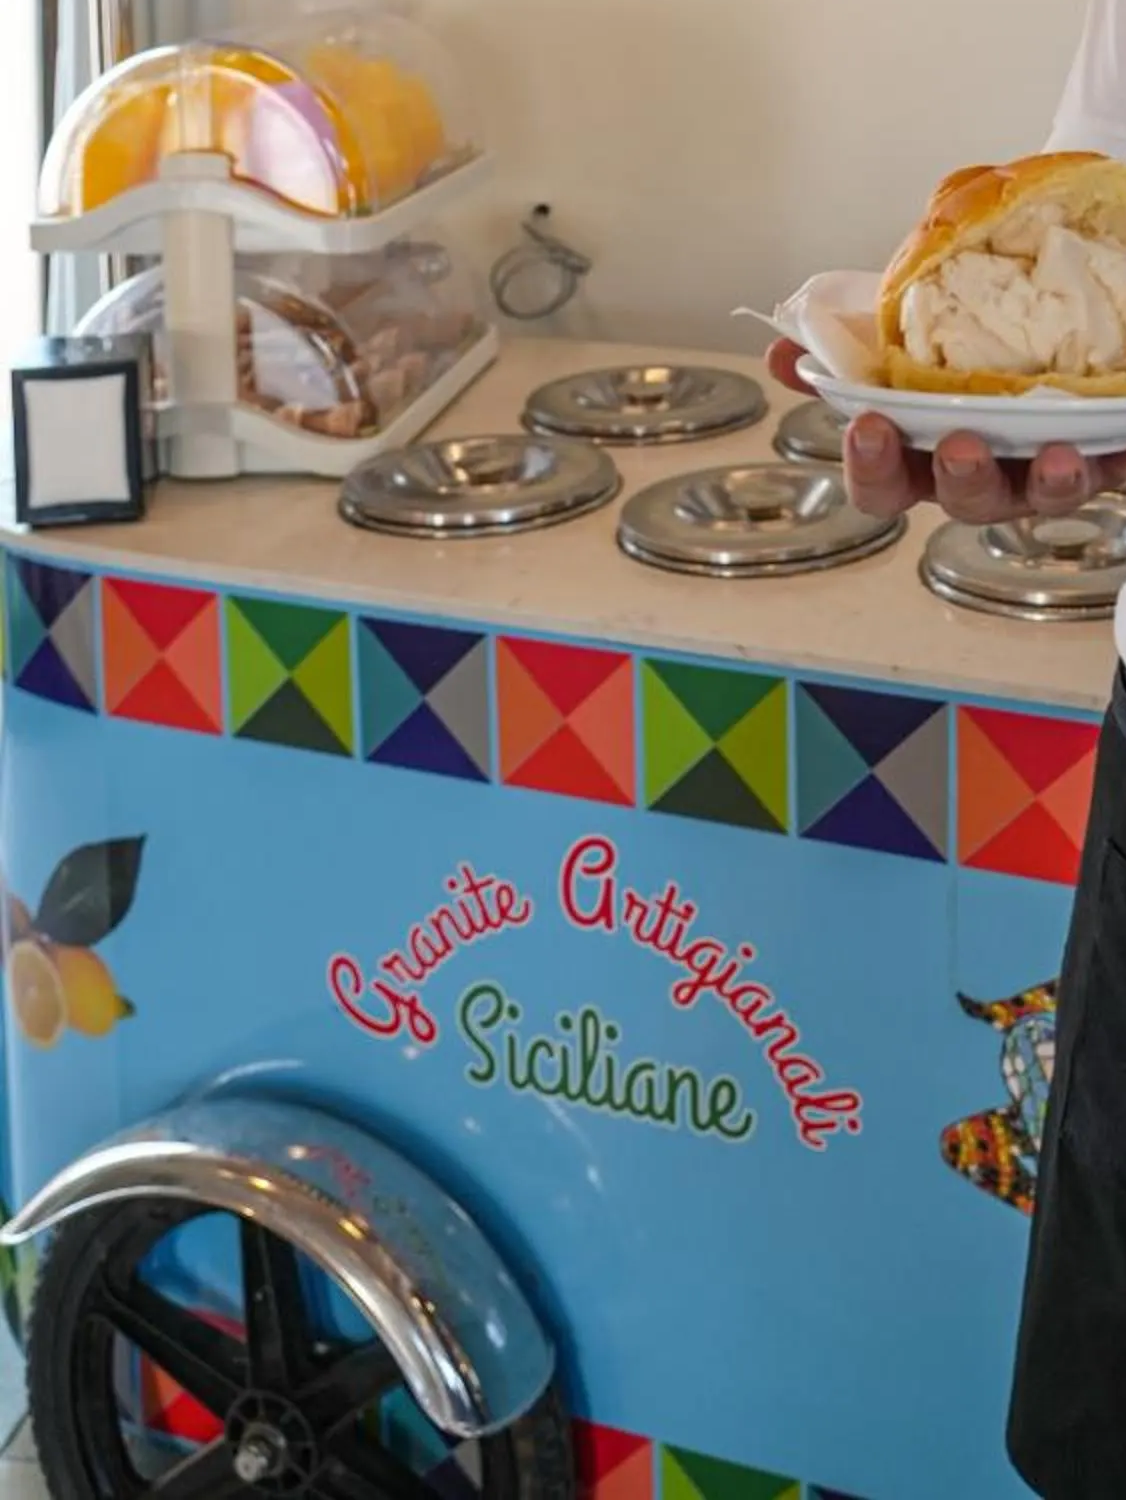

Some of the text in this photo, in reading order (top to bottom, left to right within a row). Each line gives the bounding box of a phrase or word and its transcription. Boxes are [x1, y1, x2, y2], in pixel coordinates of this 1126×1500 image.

[328, 835, 861, 1150] Granite Artigianali
[458, 983, 755, 1140] Siciliane
